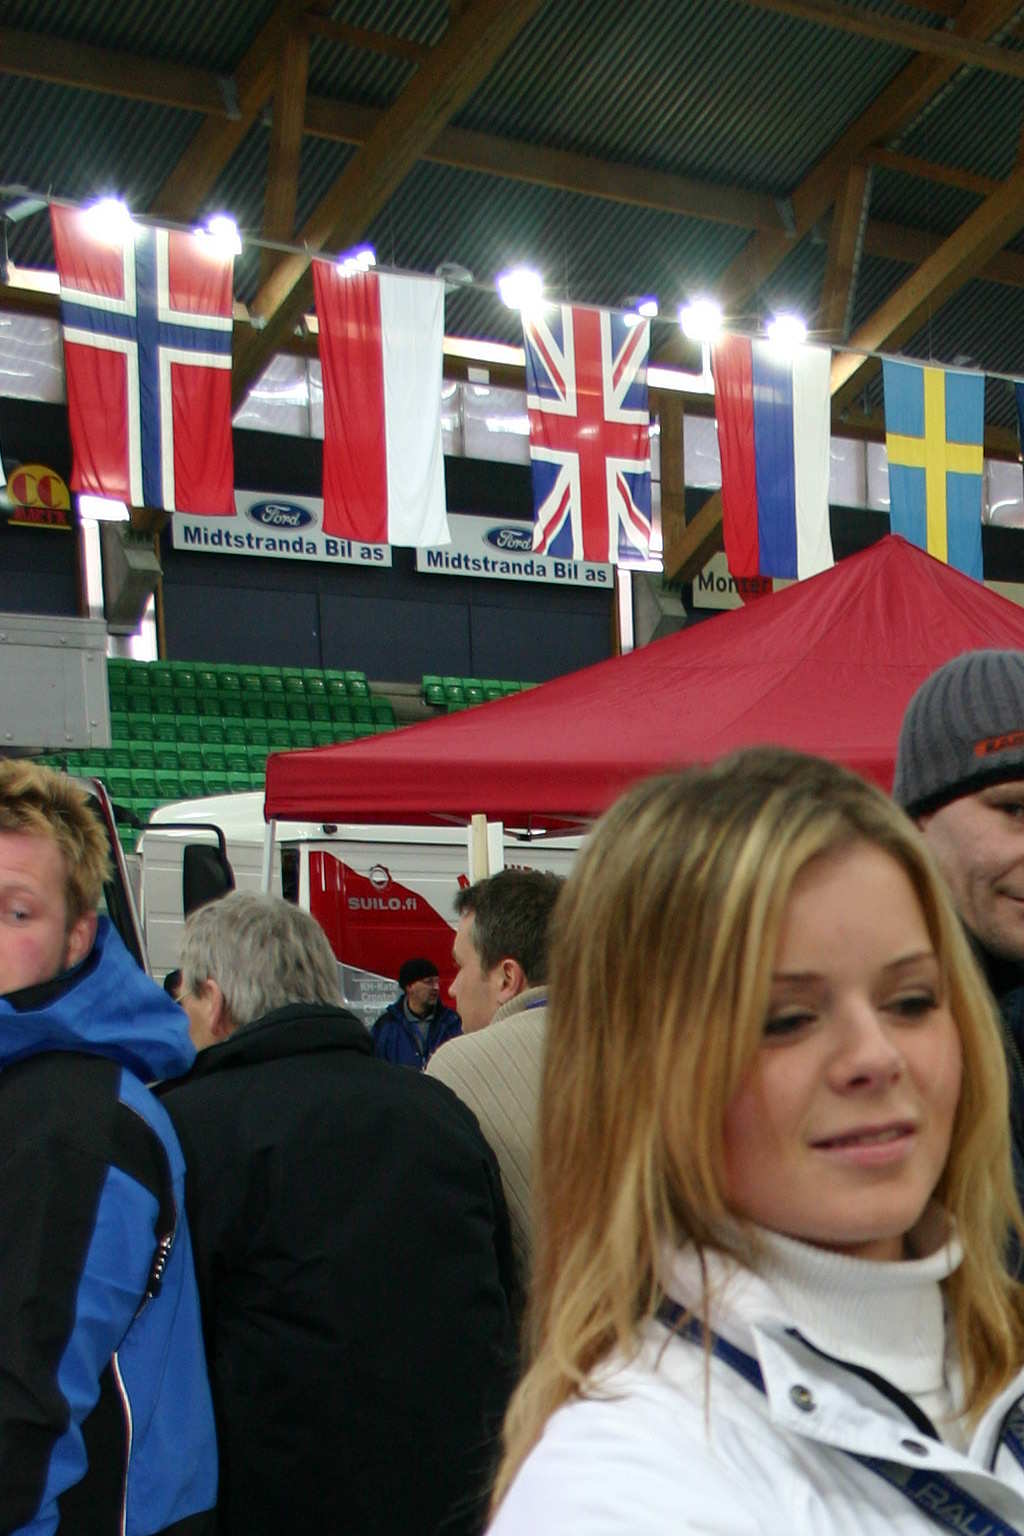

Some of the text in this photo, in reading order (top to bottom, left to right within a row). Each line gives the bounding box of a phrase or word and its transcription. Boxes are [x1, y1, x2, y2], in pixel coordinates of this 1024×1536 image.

[261, 504, 300, 526] Ford
[183, 525, 384, 561] Midtstranda Bil as
[496, 530, 532, 551] Ford
[427, 550, 607, 583] Midtstranda Bil as
[698, 571, 769, 593] Monter
